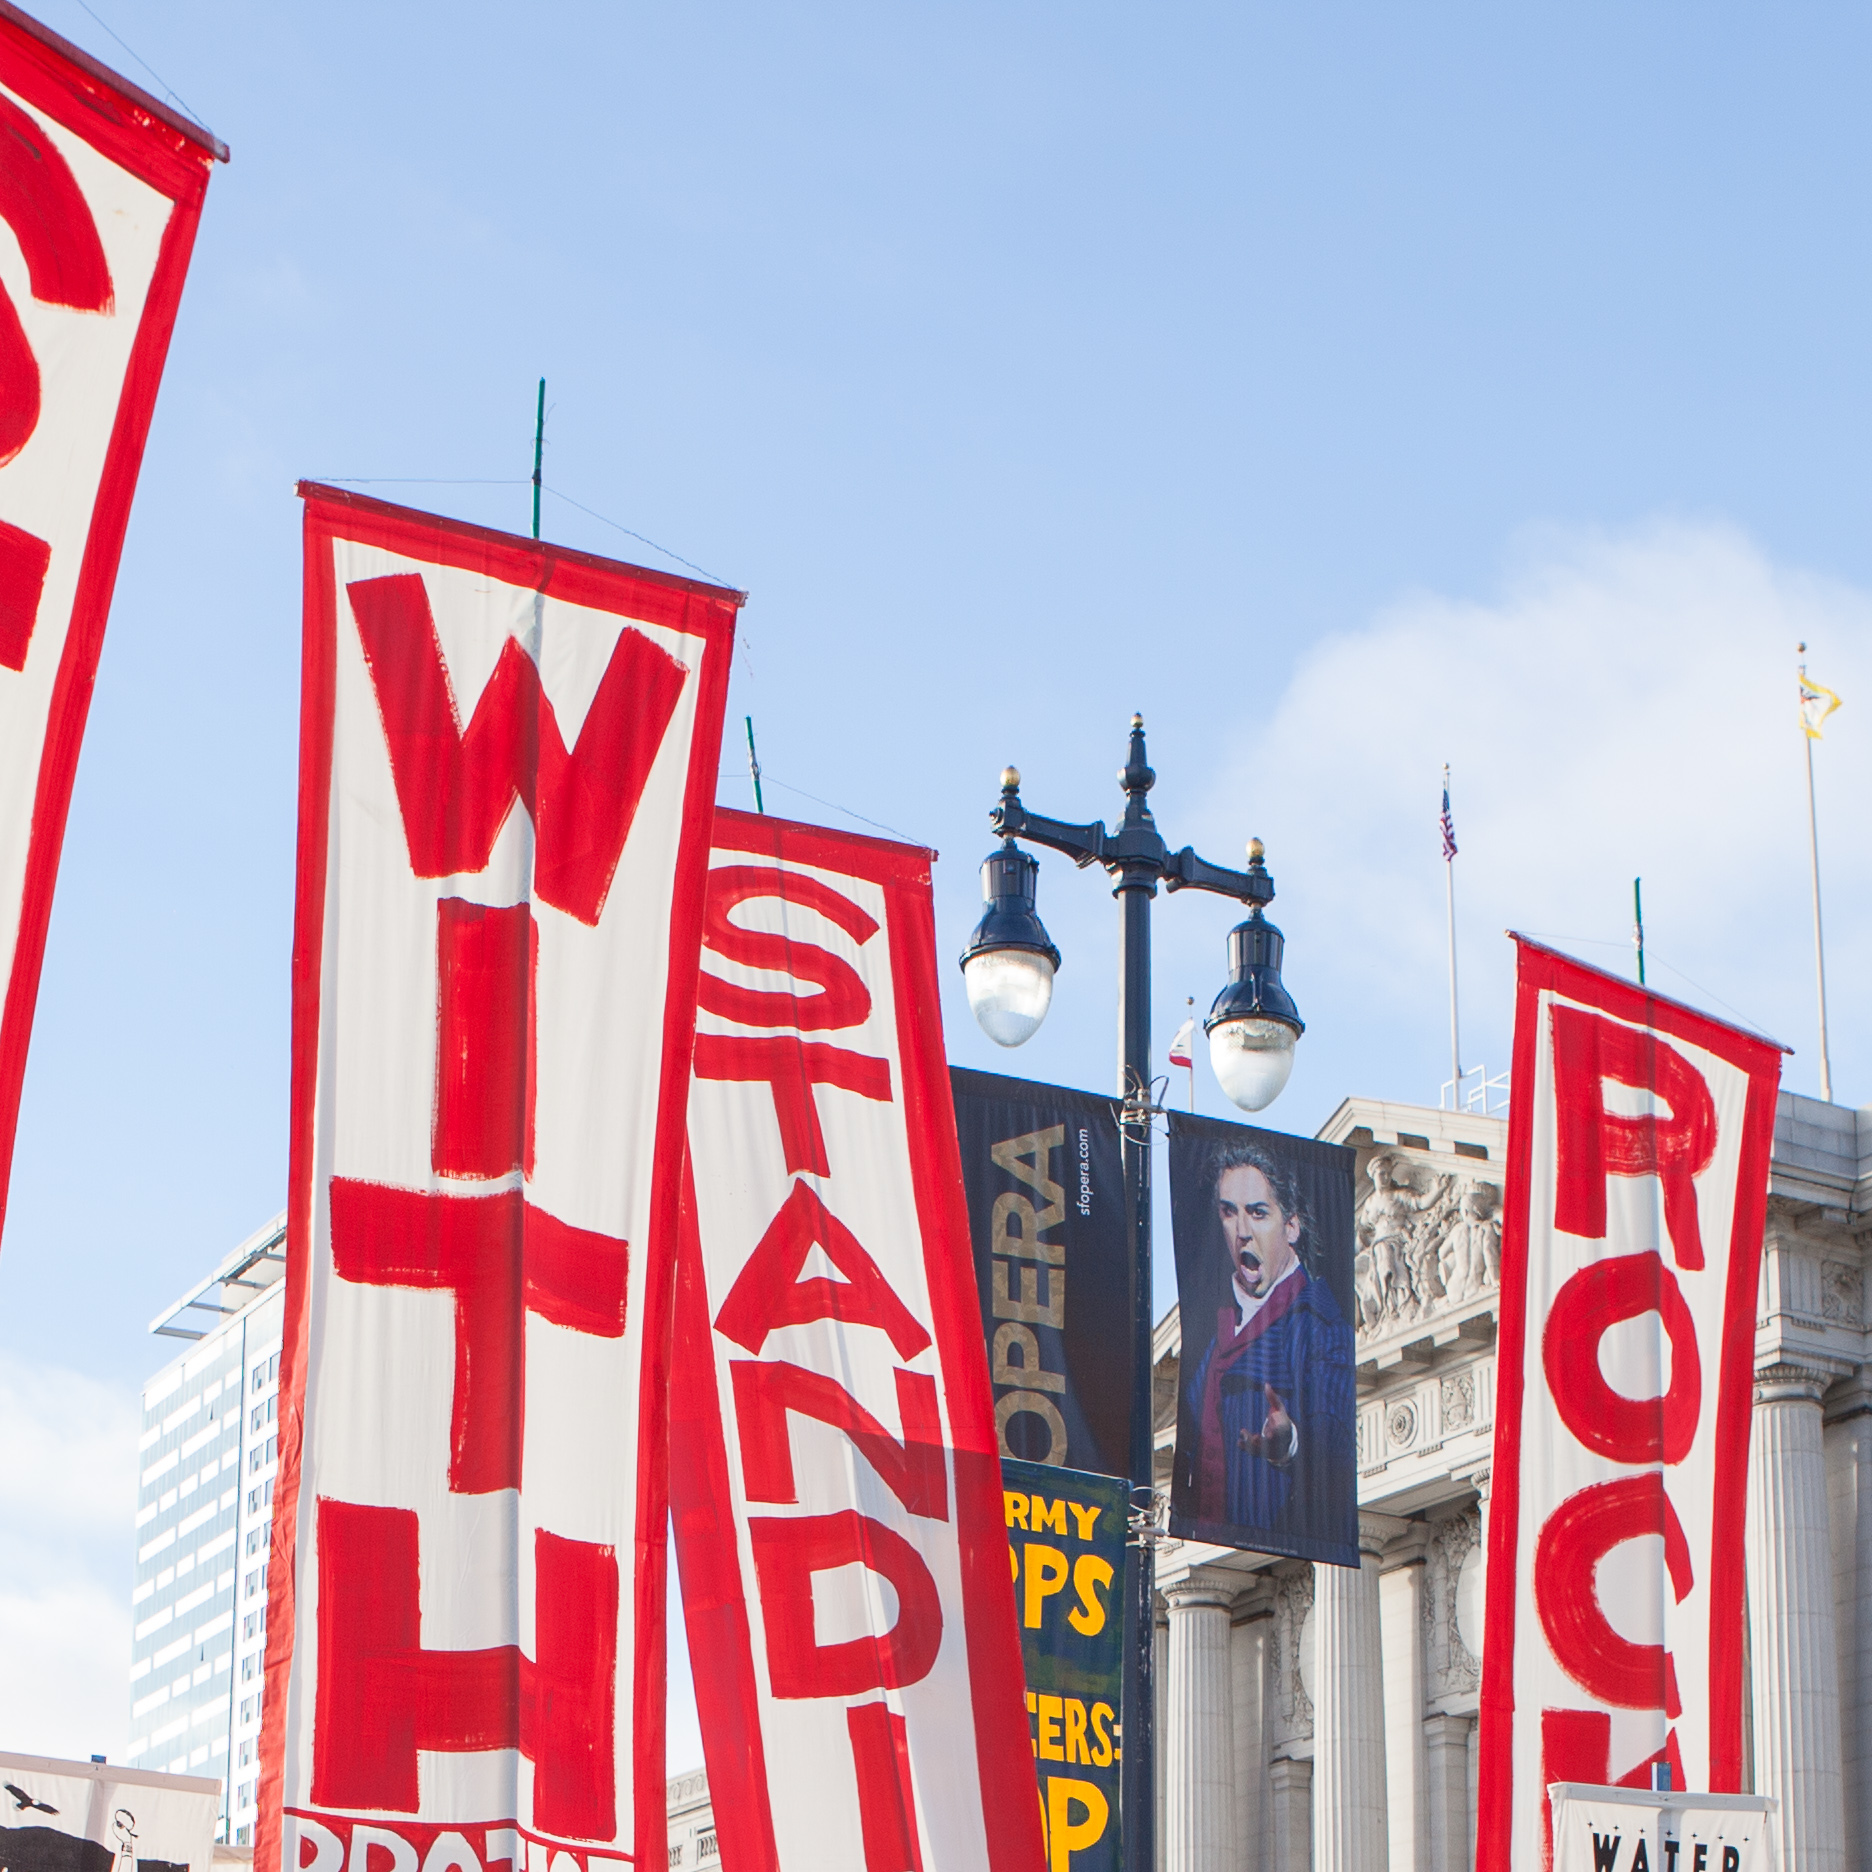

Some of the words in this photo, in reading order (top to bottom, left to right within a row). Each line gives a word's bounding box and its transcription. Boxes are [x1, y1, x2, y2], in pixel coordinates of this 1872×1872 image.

[311, 572, 691, 1843] WITH
[1076, 1128, 1095, 1216] sfopera.com
[991, 1123, 1068, 1470] OPERA
[1003, 1490, 1102, 1542] RMY
